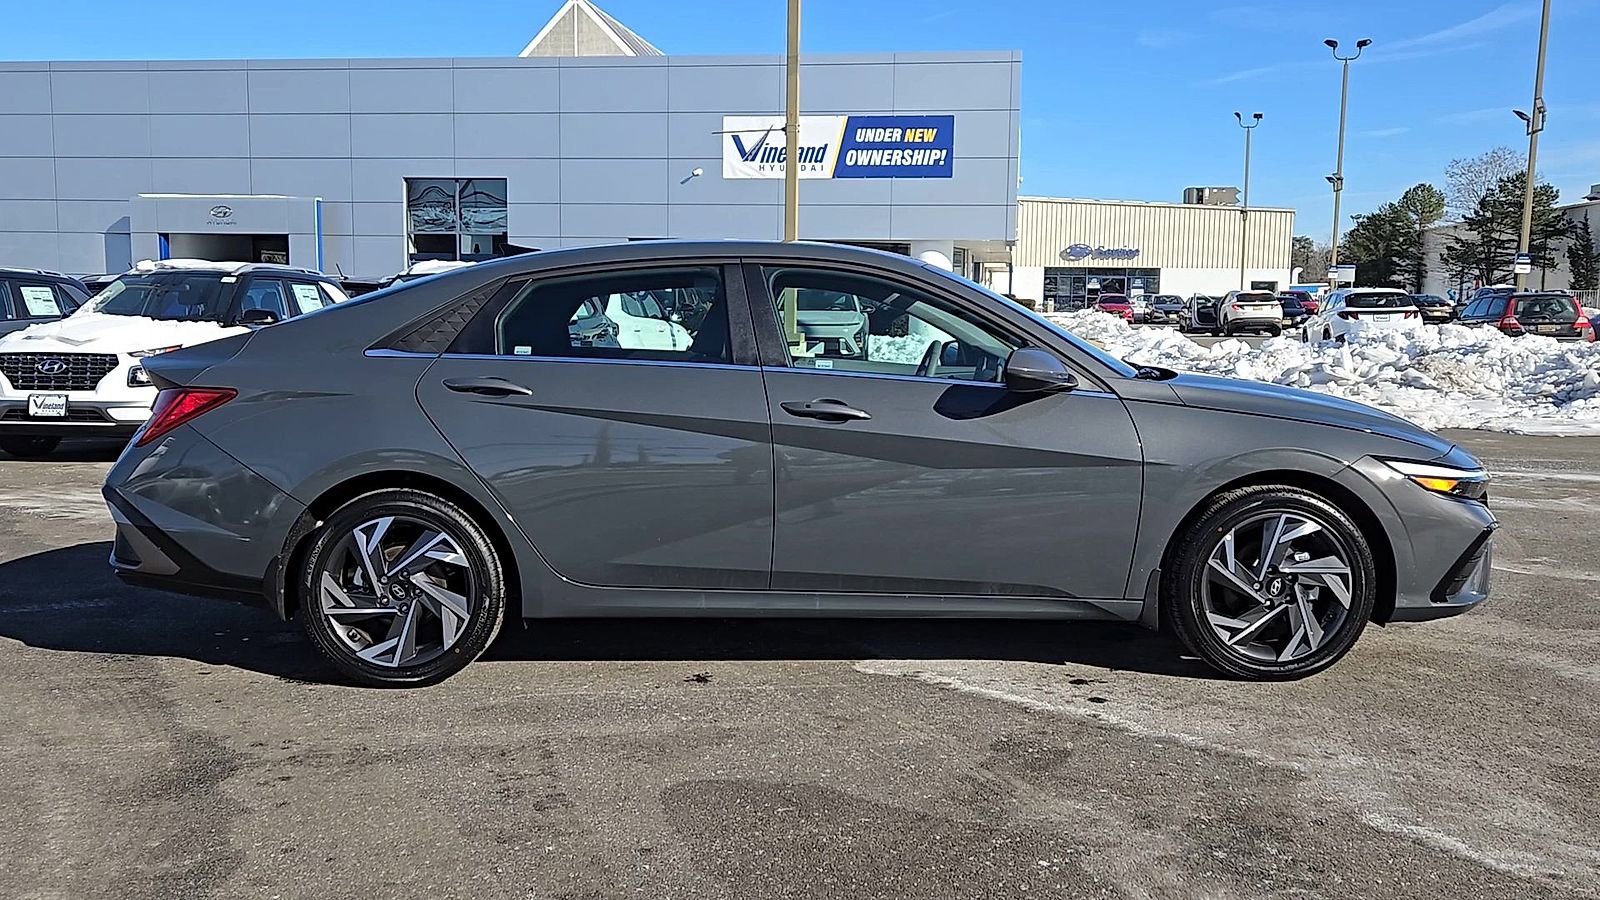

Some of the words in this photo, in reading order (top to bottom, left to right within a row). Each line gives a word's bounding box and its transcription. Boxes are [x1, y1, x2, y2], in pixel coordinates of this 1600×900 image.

[855, 127, 902, 142] UNDER
[904, 127, 938, 142] NEW
[731, 124, 828, 164] Vineand
[845, 148, 947, 166] OWNERSHIP!
[758, 164, 824, 172] HYUDAI
